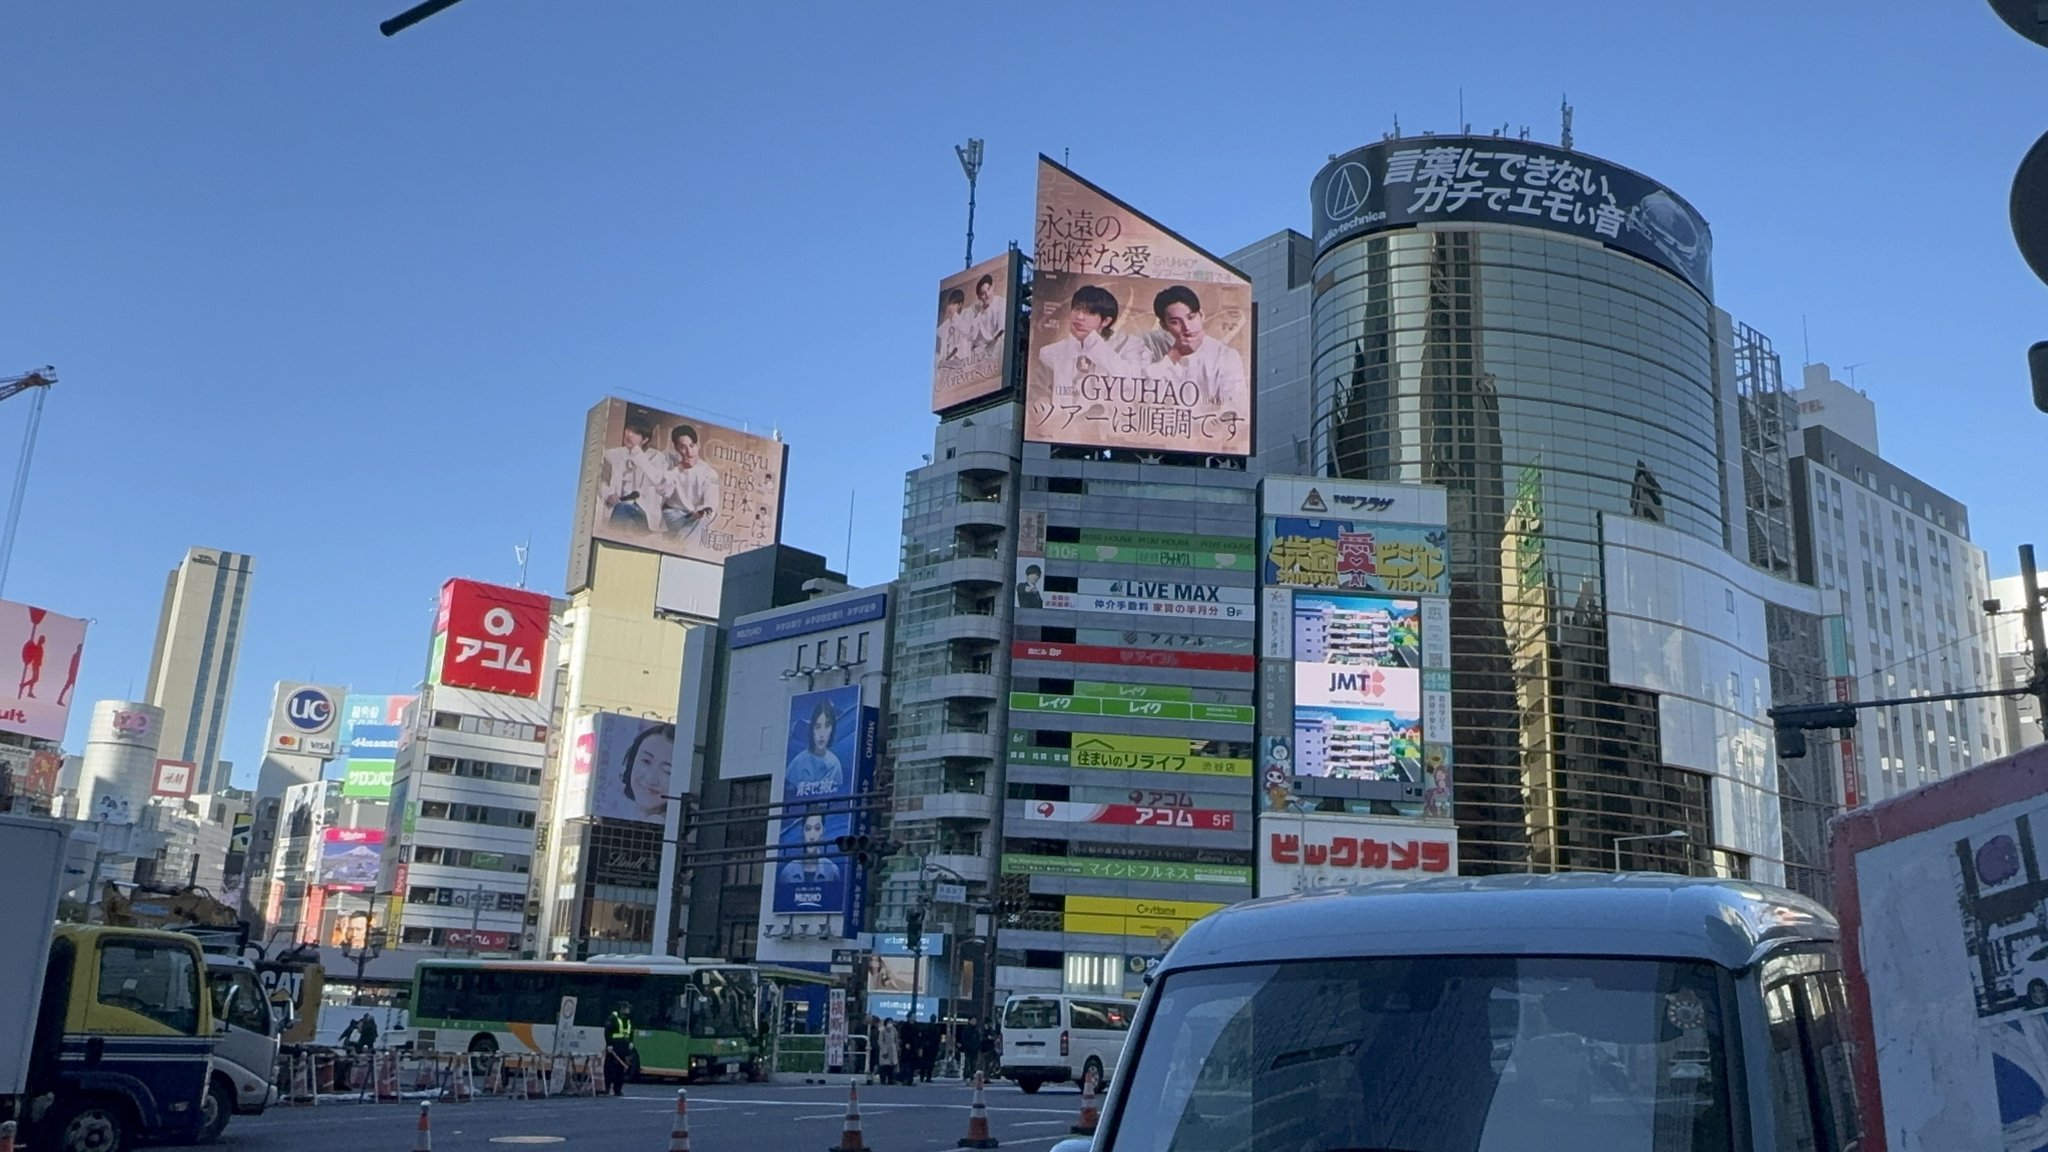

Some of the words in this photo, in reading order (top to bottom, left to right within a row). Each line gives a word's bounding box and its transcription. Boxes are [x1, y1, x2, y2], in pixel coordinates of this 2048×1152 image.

[1383, 147, 1614, 208] 言葉にできない、
[1406, 180, 1625, 239] ガチでエモい音
[1036, 205, 1121, 242] 永遠の
[1081, 374, 1199, 407] GYUHAO
[1032, 402, 1246, 442] ツアーは順調です
[714, 444, 769, 472] mingyu
[723, 468, 755, 492] the8
[722, 491, 752, 514] 日本
[1174, 584, 1220, 602] MAX
[1276, 570, 1338, 588] SHIBUYA
[1349, 574, 1366, 588] AI
[1387, 579, 1439, 593] VISION
[455, 636, 532, 674] アコム
[1119, 686, 1147, 697] レイク
[1328, 672, 1371, 692] JMT
[291, 697, 328, 721] UC
[1038, 696, 1071, 709] レイク
[1129, 701, 1162, 714] レイク
[310, 741, 330, 749] VISA
[864, 720, 876, 759] MIZUHO
[1078, 751, 1186, 769] 住まいのリライフ
[1148, 791, 1194, 807] アコム
[1135, 806, 1195, 828] アコム
[1212, 815, 1232, 827] 5F
[1089, 861, 1190, 880] マインドフルネス
[263, 970, 304, 1002] CAT
